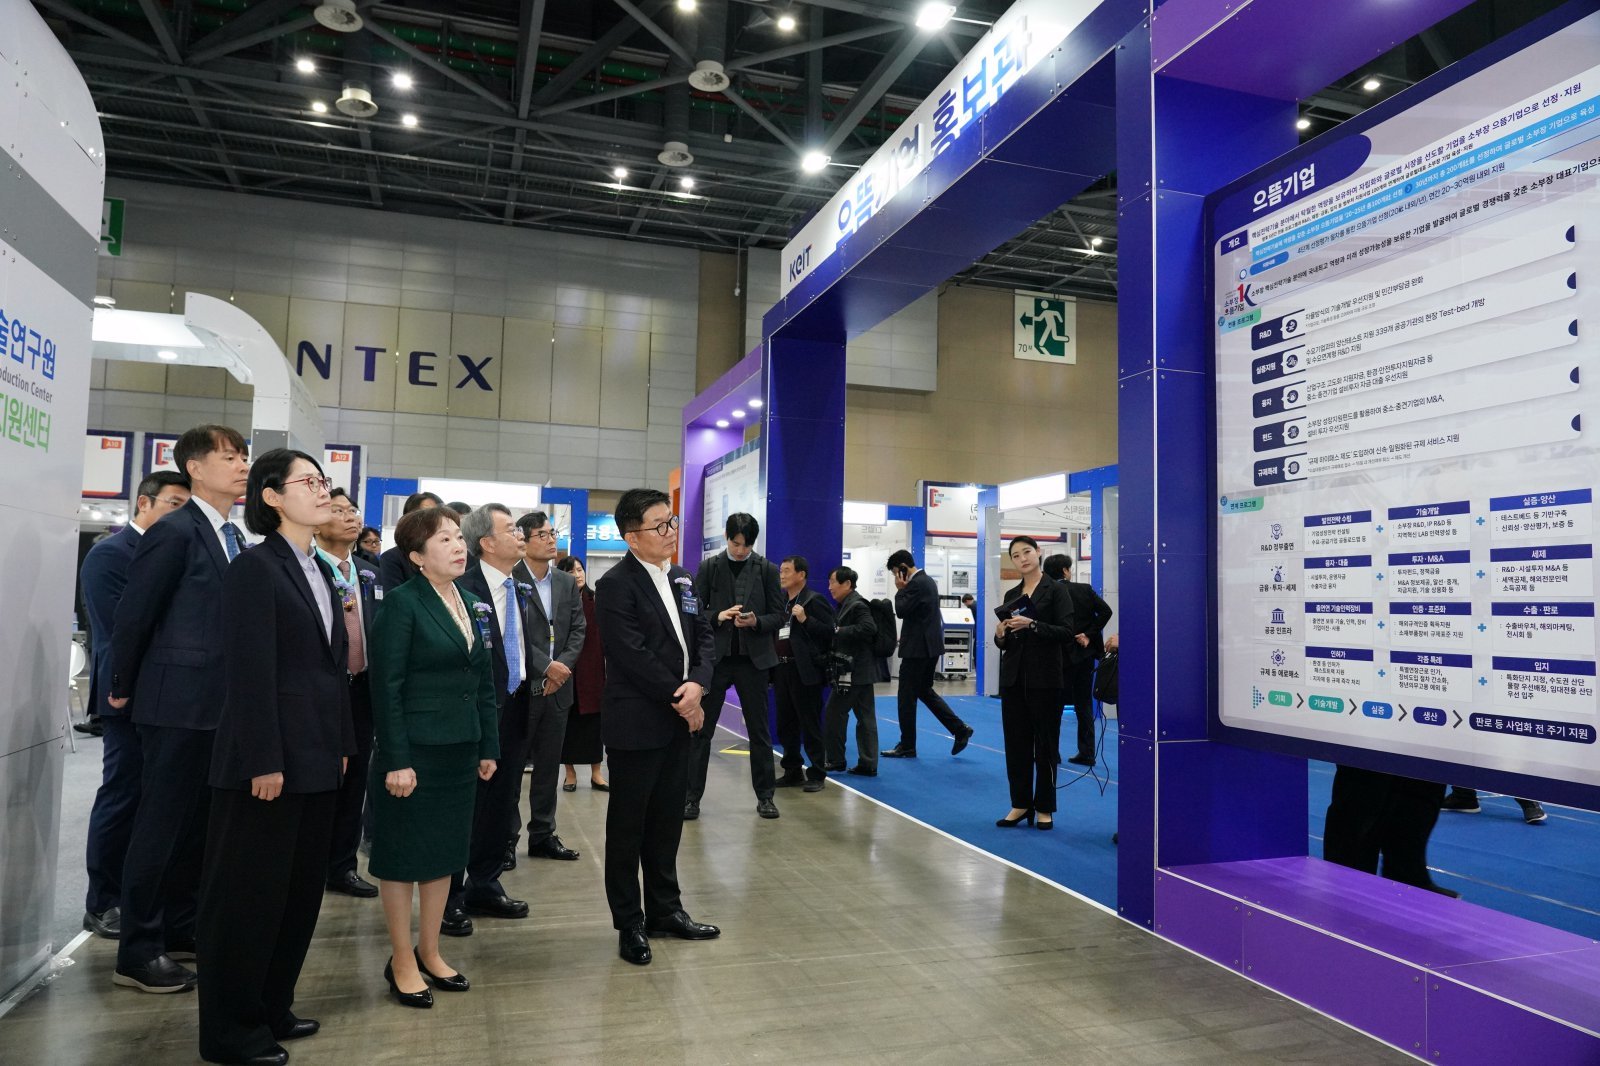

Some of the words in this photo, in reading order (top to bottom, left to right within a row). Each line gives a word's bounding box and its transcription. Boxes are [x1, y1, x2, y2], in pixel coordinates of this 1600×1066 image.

[1384, 165, 1402, 180] 글로벌
[1404, 155, 1422, 172] 시장을
[1424, 145, 1444, 162] 선도할
[1446, 135, 1465, 152] 기업을
[1468, 124, 1489, 141] 소부장
[1492, 101, 1539, 131] 으뜸기업으로
[1492, 161, 1505, 174] 지원
[1253, 163, 1315, 212] 으뜸기업
[1413, 221, 1431, 236] 기업을
[1432, 211, 1458, 229] 발굴하여
[1459, 202, 1480, 218] 글로벌
[1530, 174, 1553, 192] 소부장
[1556, 156, 1600, 181] 대표기업으
[1363, 330, 1374, 340] 지원
[1439, 302, 1470, 318] Test-bed
[31, 382, 53, 404] Center
[1447, 433, 1460, 444] 지원
[1541, 509, 1568, 518] 기반구축
[1276, 627, 1292, 635] 인프라
[1534, 662, 1550, 671] 입지
[1271, 669, 1277, 677] 등
[1507, 690, 1520, 699] 우선
[1521, 691, 1534, 699] 입주
[1578, 687, 1593, 696] 산단
[1314, 698, 1338, 710] 기술개발
[1423, 712, 1438, 722] 생산
[1475, 717, 1492, 727] 판로
[1494, 719, 1504, 729] 등
[1506, 720, 1533, 733] 사업화
[1535, 724, 1544, 735] 전
[1546, 726, 1566, 737] 주기
[1568, 727, 1588, 740] 지원
